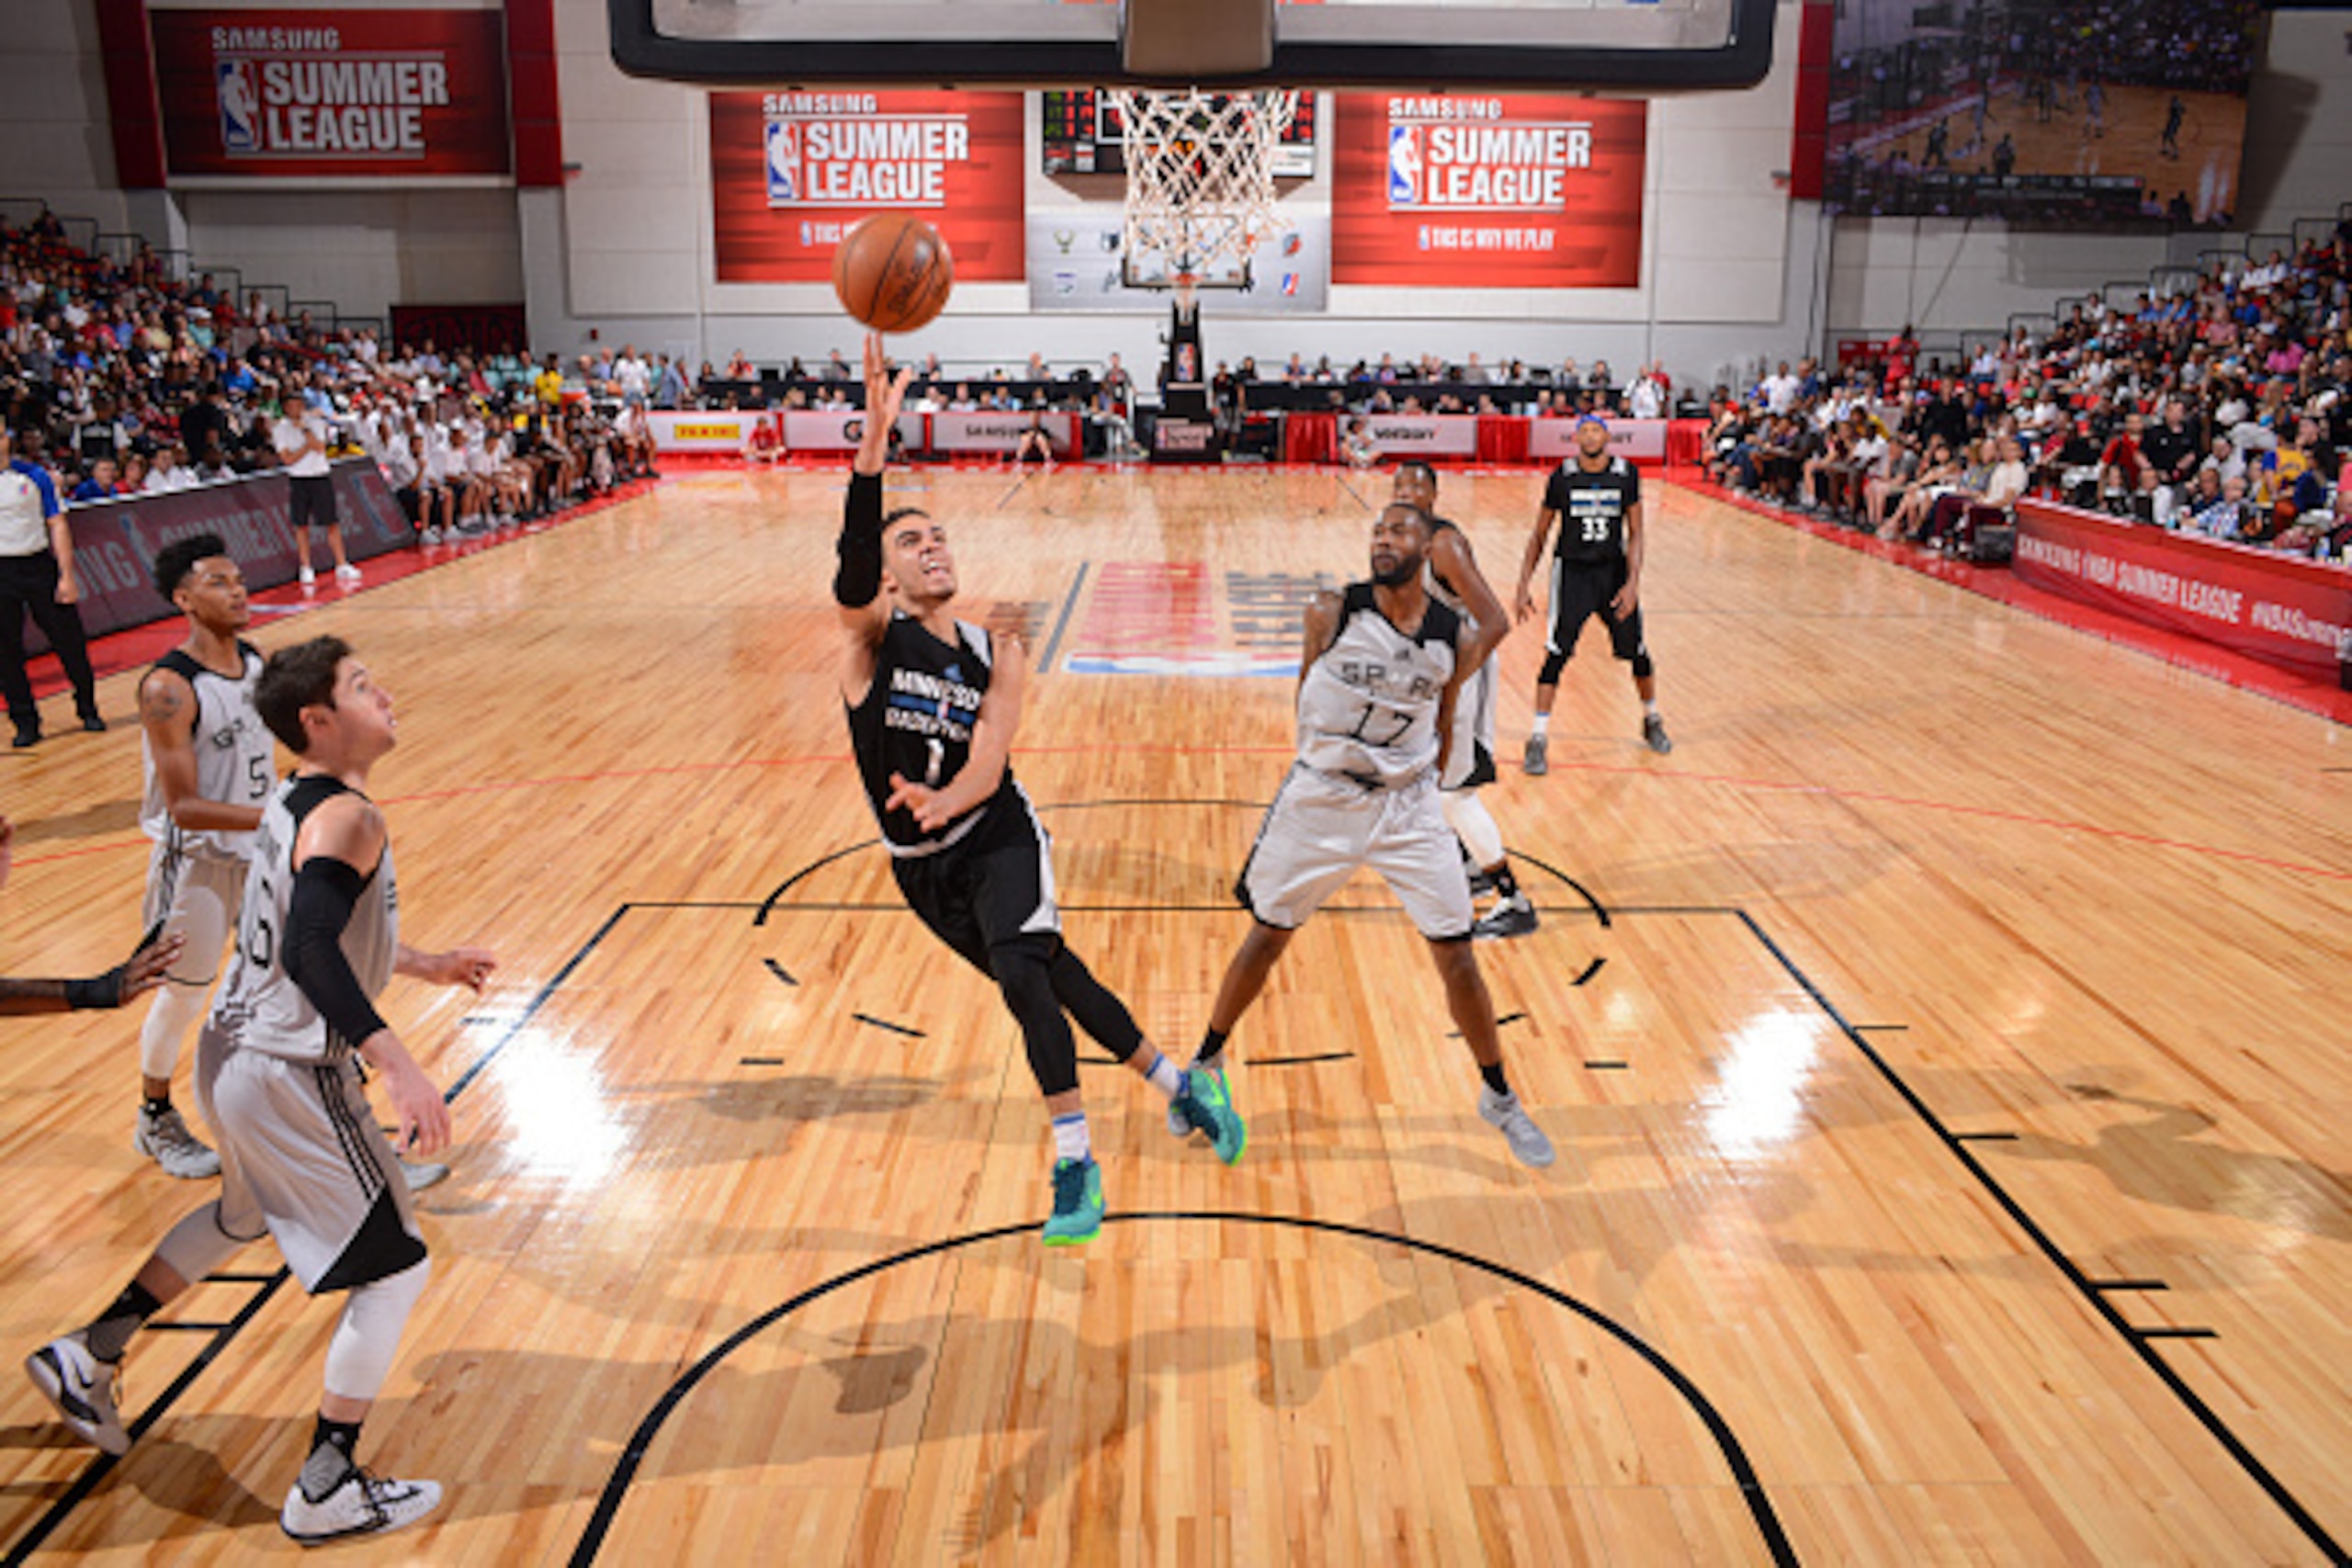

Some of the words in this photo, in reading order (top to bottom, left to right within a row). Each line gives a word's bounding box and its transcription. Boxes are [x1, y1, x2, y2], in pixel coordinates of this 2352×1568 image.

[211, 26, 342, 51] SAMSUNG
[263, 61, 449, 106] SUMMER
[763, 94, 878, 114] SAMSUNG
[266, 106, 425, 151] LEAGUE
[1387, 97, 1503, 119] SAMSUNG
[806, 120, 968, 161] SUMMER
[1429, 126, 1592, 167] SUMMER
[807, 161, 945, 200] LEAGUE
[1427, 166, 1566, 205] LEAGUE
[1581, 516, 1610, 542] 33
[2117, 560, 2179, 606] SUMMER
[2180, 578, 2244, 625] LEAGUE
[1346, 702, 1416, 748] 17
[249, 753, 270, 800] 5
[925, 738, 944, 787] 1
